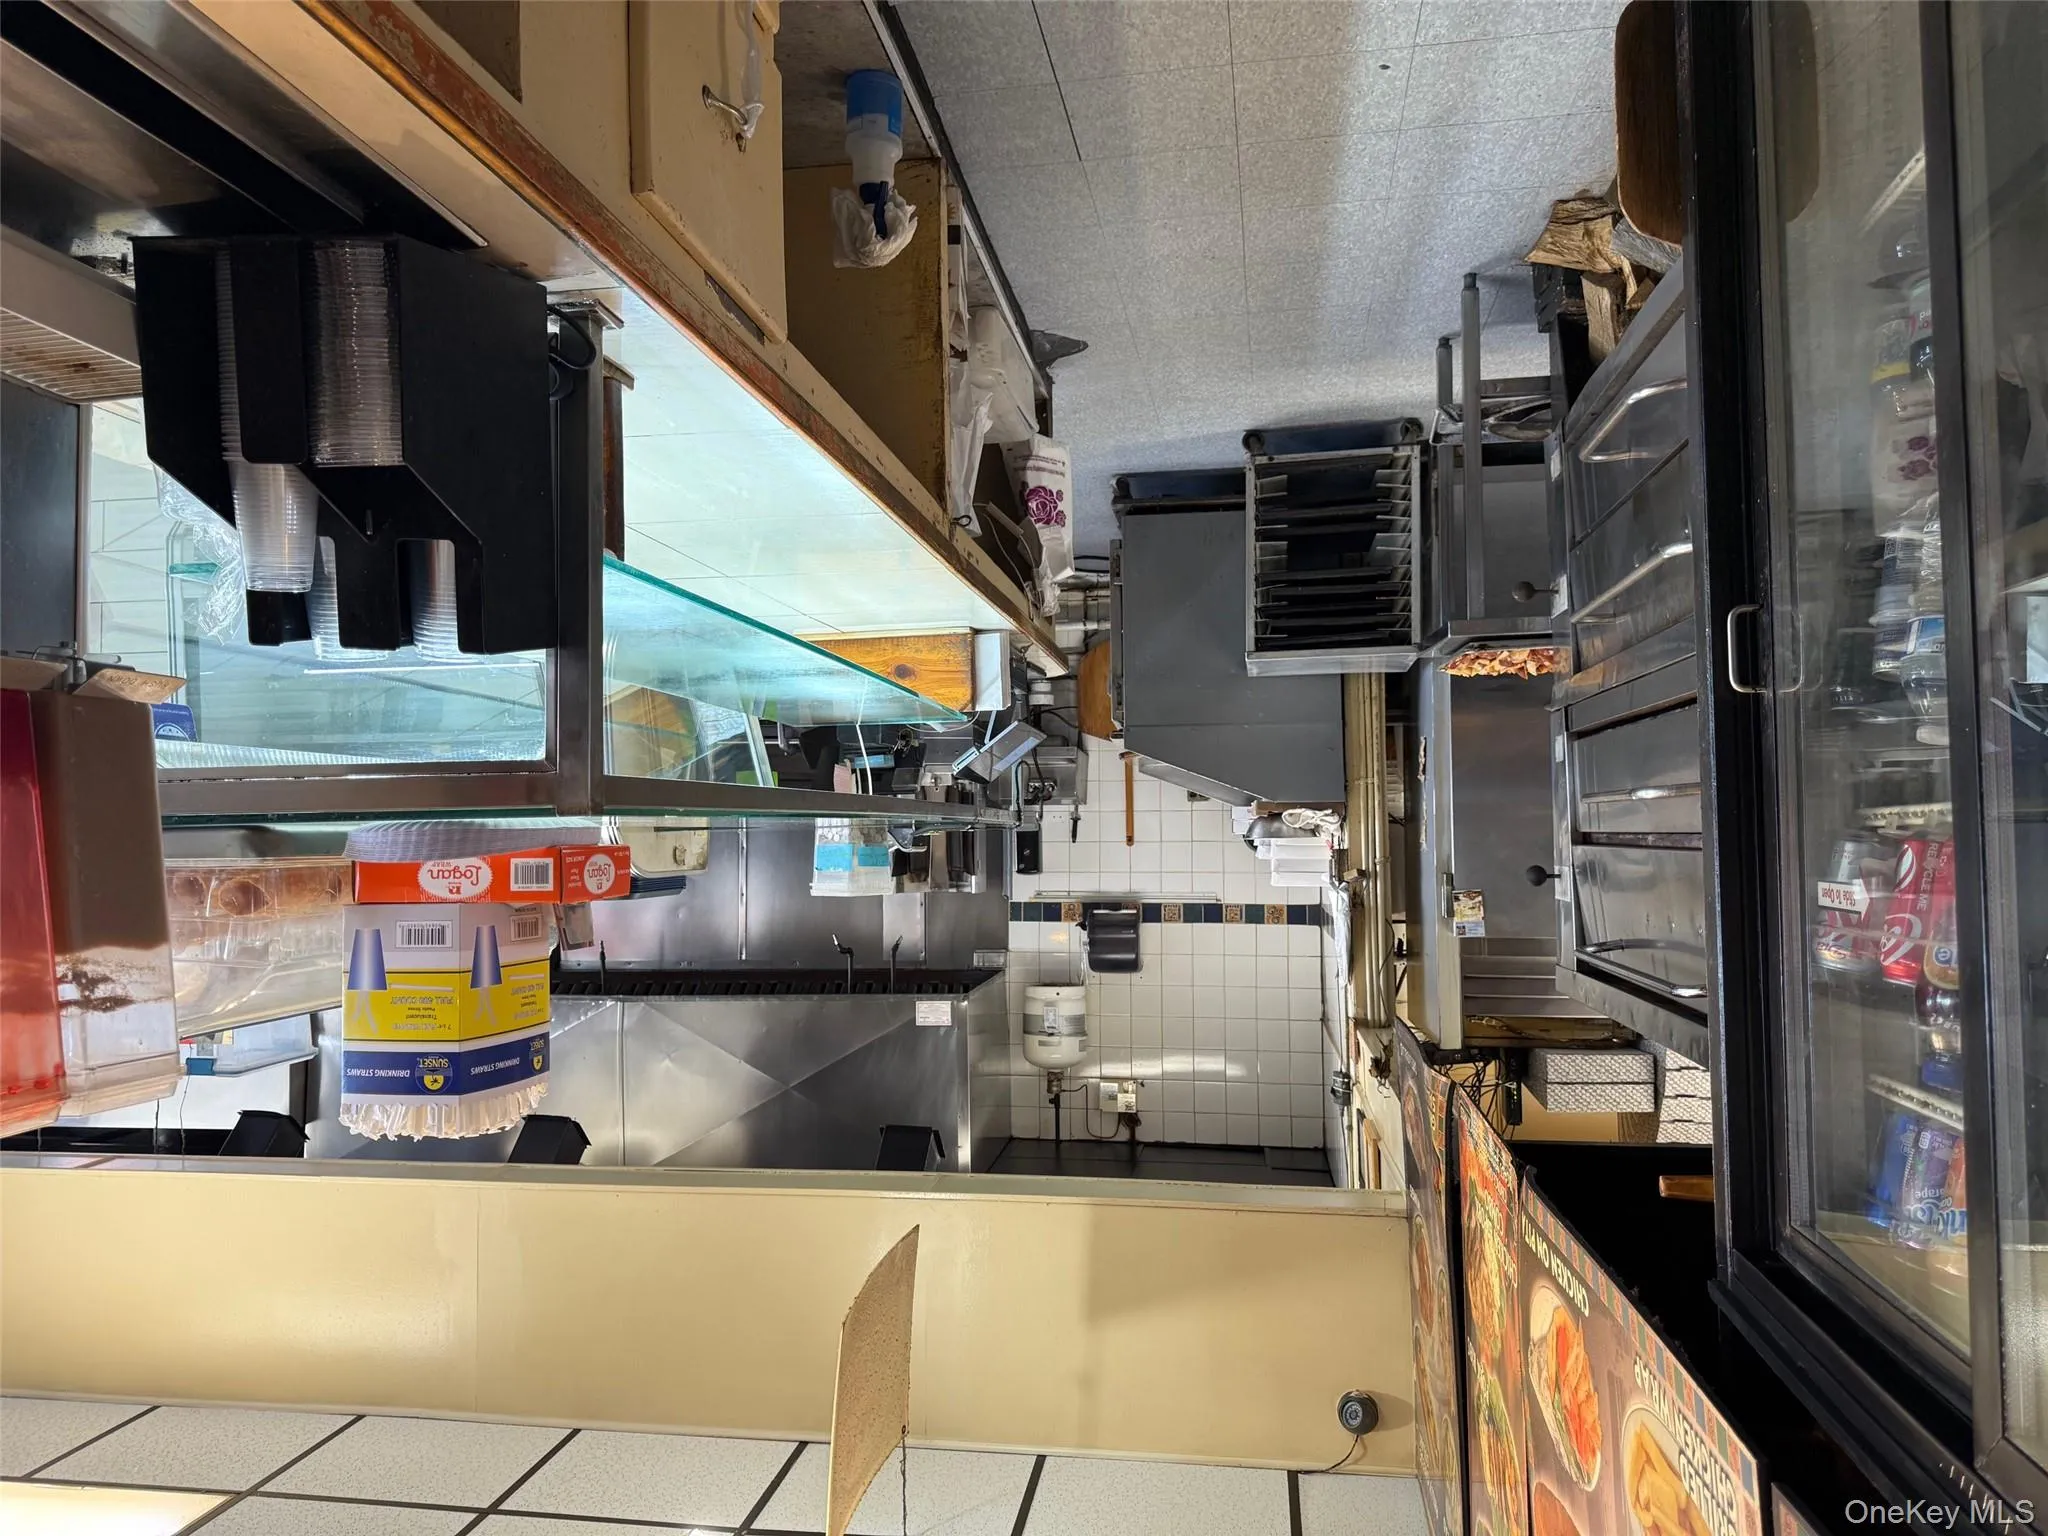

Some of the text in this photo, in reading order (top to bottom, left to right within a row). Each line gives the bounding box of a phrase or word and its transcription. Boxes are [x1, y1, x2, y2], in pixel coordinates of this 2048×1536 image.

[428, 865, 481, 886] Logan
[1822, 884, 1856, 906] Slide To Open
[347, 1068, 410, 1077] DRINKING STRAWS
[419, 1058, 449, 1068] SUNSET
[470, 1057, 520, 1075] DRINKING STRAWS
[1521, 1211, 1589, 1318] CHICKEN ON PITA
[1634, 1356, 1736, 1522] CHICKEN WRAP
